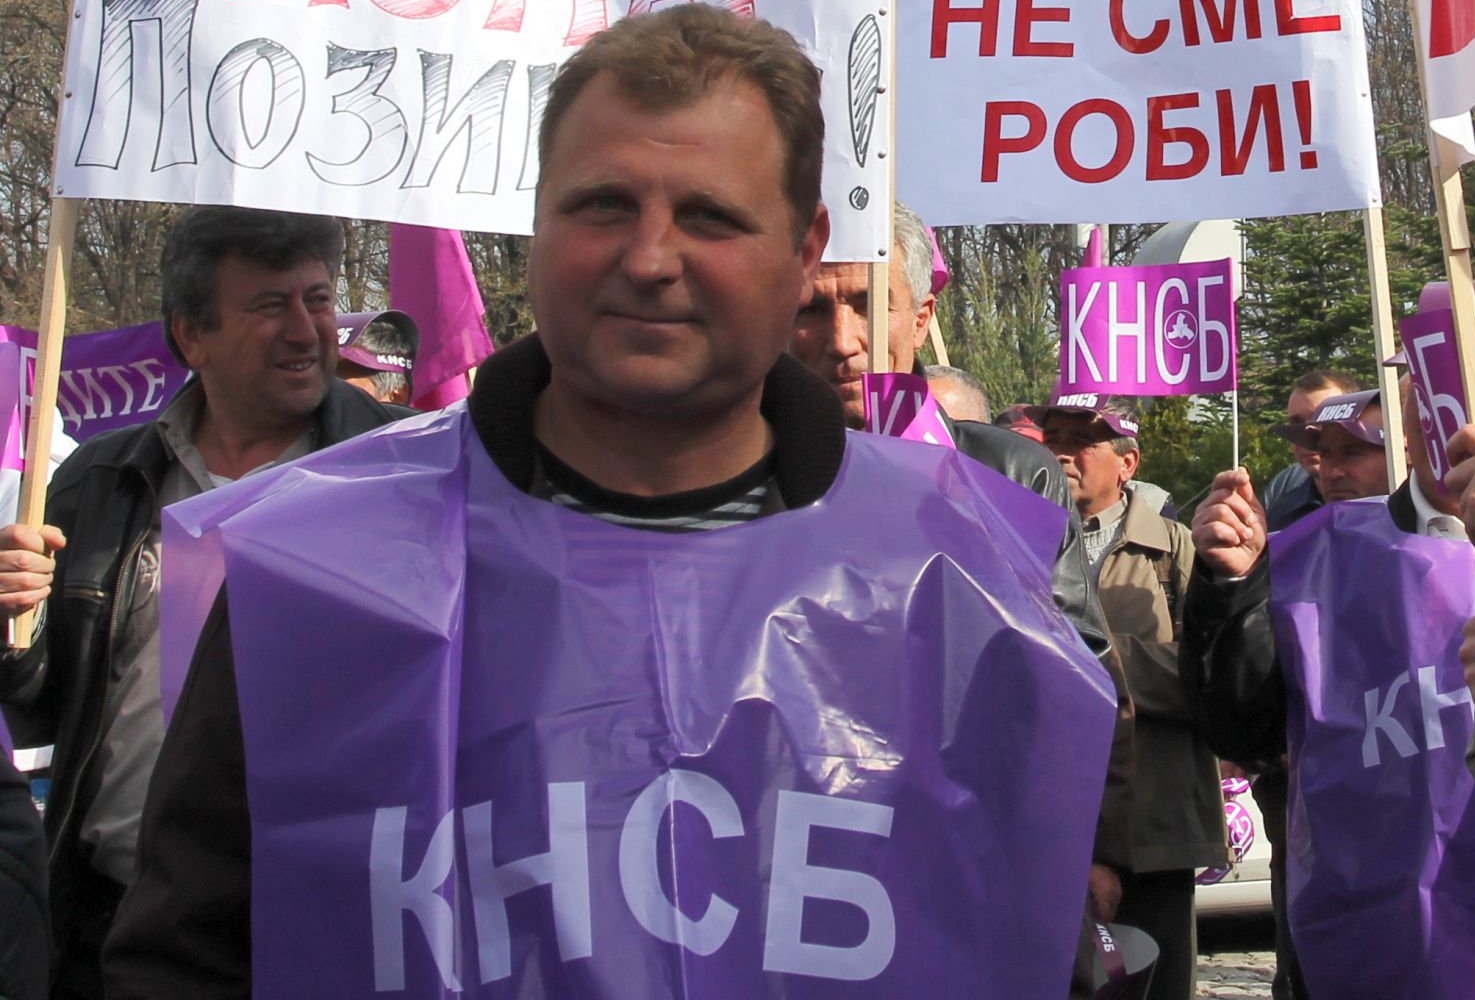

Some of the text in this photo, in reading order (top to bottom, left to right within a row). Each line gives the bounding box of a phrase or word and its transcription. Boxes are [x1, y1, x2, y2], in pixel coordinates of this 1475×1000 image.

[981, 80, 1318, 184] РОБИ!
[376, 354, 412, 370] КНСБ
[1068, 275, 1230, 385] КНСБ
[1316, 402, 1357, 422] КНСБ
[369, 767, 897, 993] КНСБ
